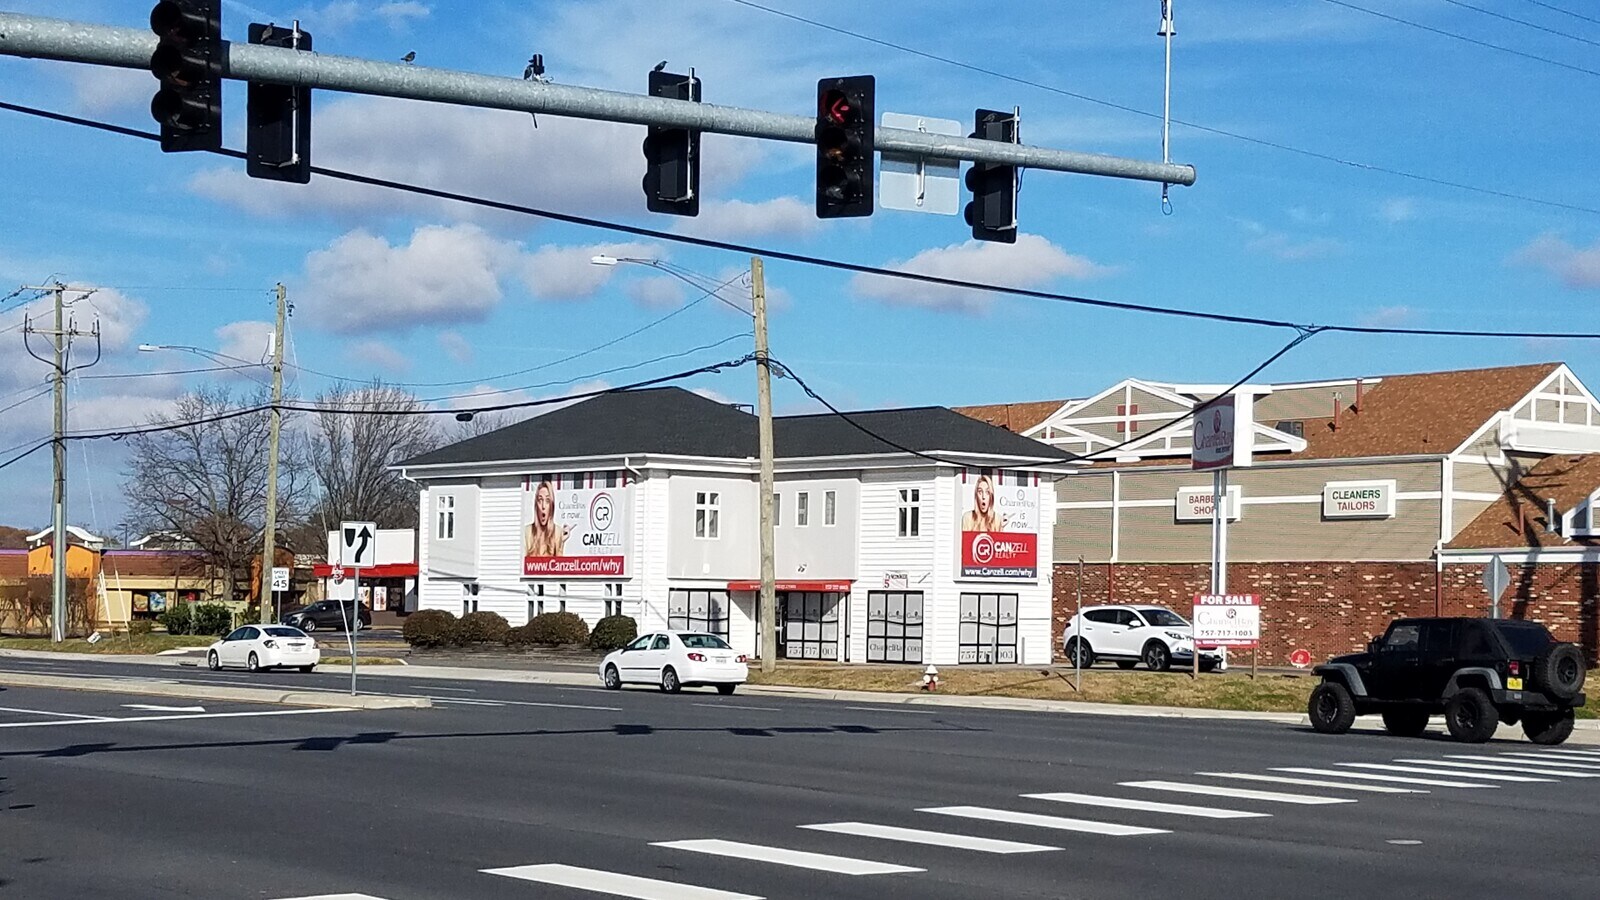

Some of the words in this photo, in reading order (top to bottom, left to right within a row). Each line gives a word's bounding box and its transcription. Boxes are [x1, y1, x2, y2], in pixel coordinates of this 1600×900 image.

[1332, 490, 1381, 500] CLEANERS
[1337, 501, 1375, 511] TAILORS
[595, 506, 610, 521] CR
[582, 532, 622, 546] CANZELL
[994, 541, 1029, 553] CANZELL
[526, 558, 621, 573] www.Canzell.com/why
[964, 567, 1033, 578] www.Canzell.com/why
[273, 580, 287, 588] 45
[1200, 595, 1224, 605] FOR
[1225, 595, 1252, 604] SALE
